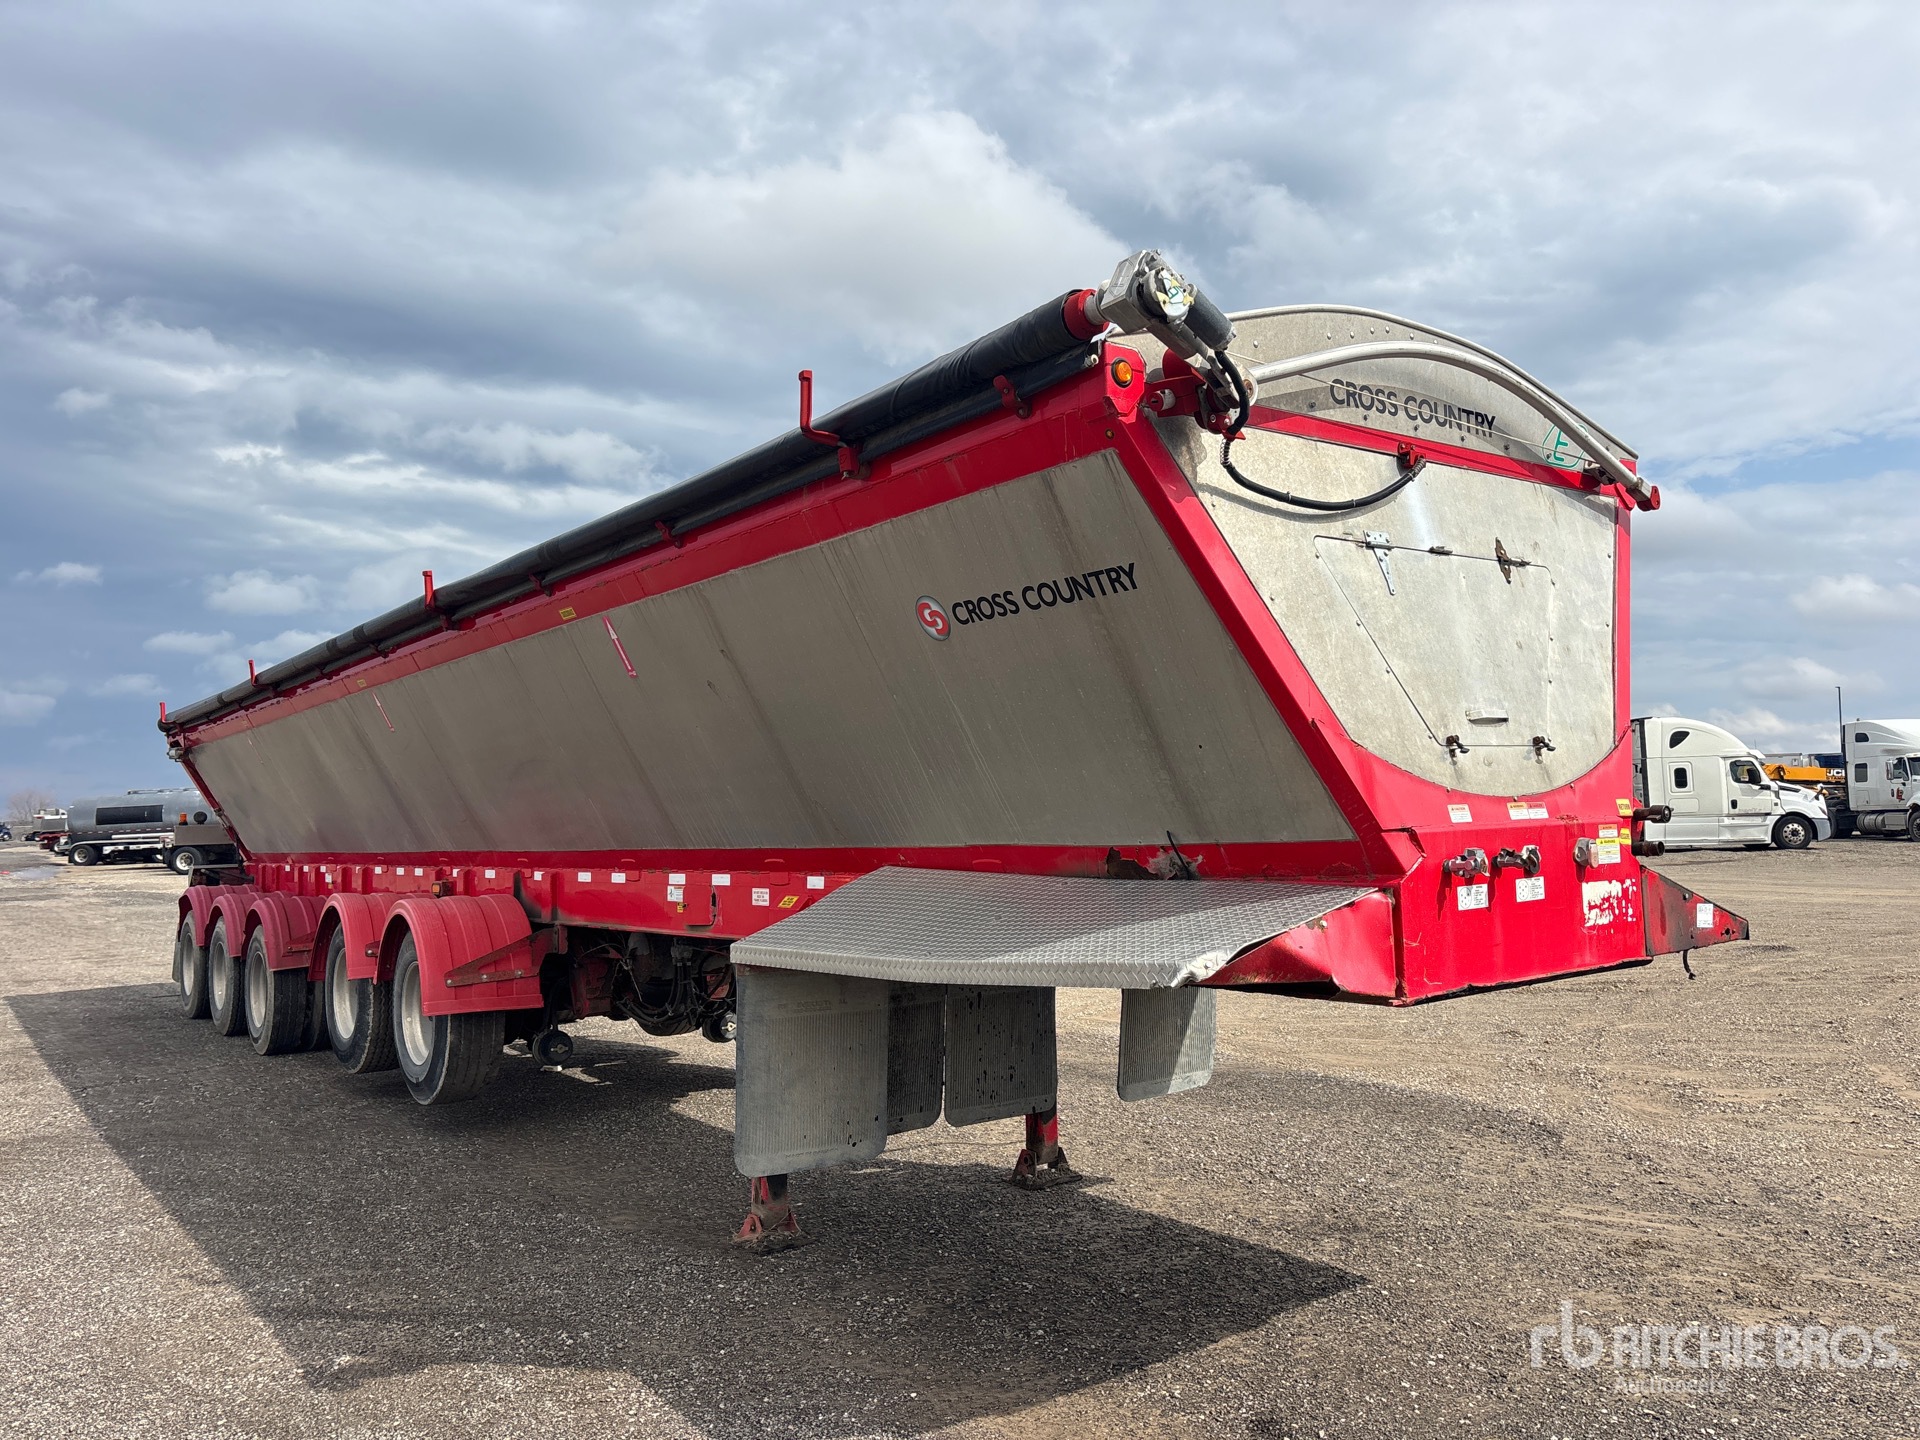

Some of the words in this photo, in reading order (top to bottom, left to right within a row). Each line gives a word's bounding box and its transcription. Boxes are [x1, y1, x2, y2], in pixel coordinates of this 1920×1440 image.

[1329, 378, 1399, 417] CROSS
[1404, 395, 1497, 438] COUNTRY
[951, 590, 1020, 626] CROSS
[1021, 562, 1138, 611] COUNTRY
